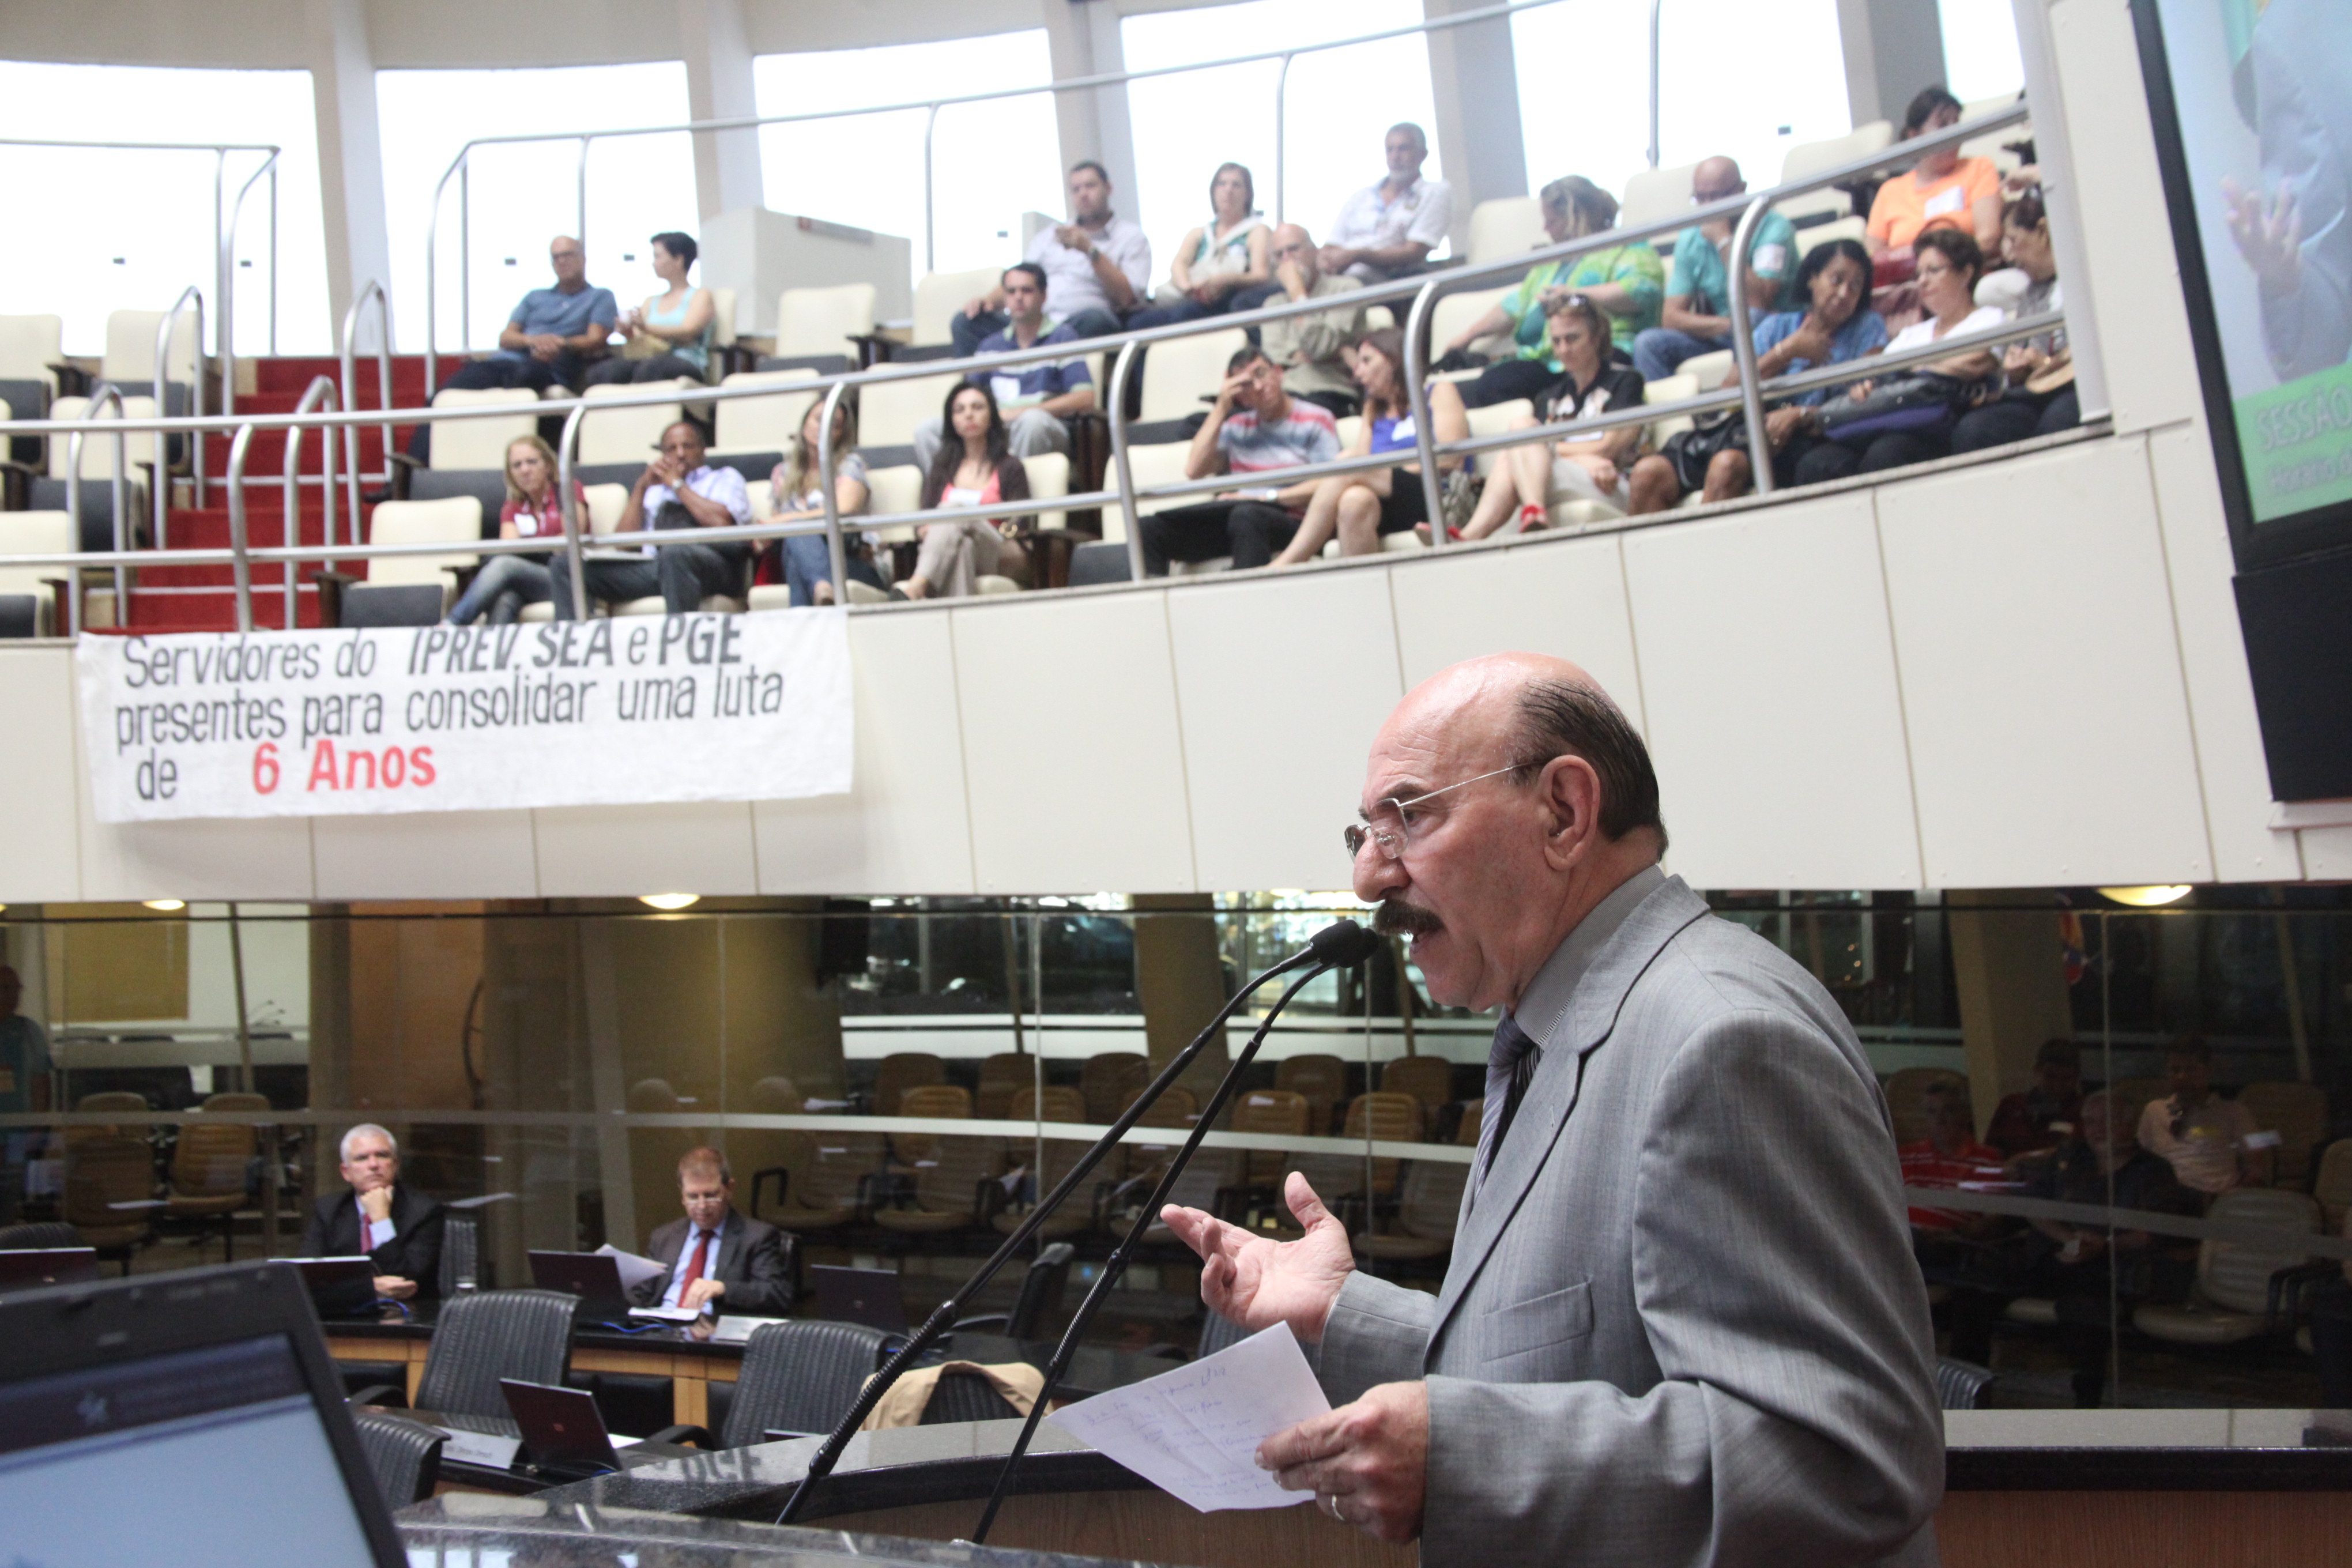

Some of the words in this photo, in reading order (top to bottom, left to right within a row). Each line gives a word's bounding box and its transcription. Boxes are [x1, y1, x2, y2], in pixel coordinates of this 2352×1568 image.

[122, 632, 319, 688] Servidores
[336, 628, 376, 677] do
[532, 619, 613, 668] SEA
[628, 626, 647, 665] e
[658, 613, 741, 665] PGE
[116, 689, 287, 755] presentes
[301, 693, 383, 749] para
[406, 673, 597, 732] consolidar
[618, 676, 696, 720] uma
[714, 665, 783, 717] luta
[136, 748, 178, 801] de
[252, 741, 281, 796] 6
[307, 738, 436, 792] Anos
